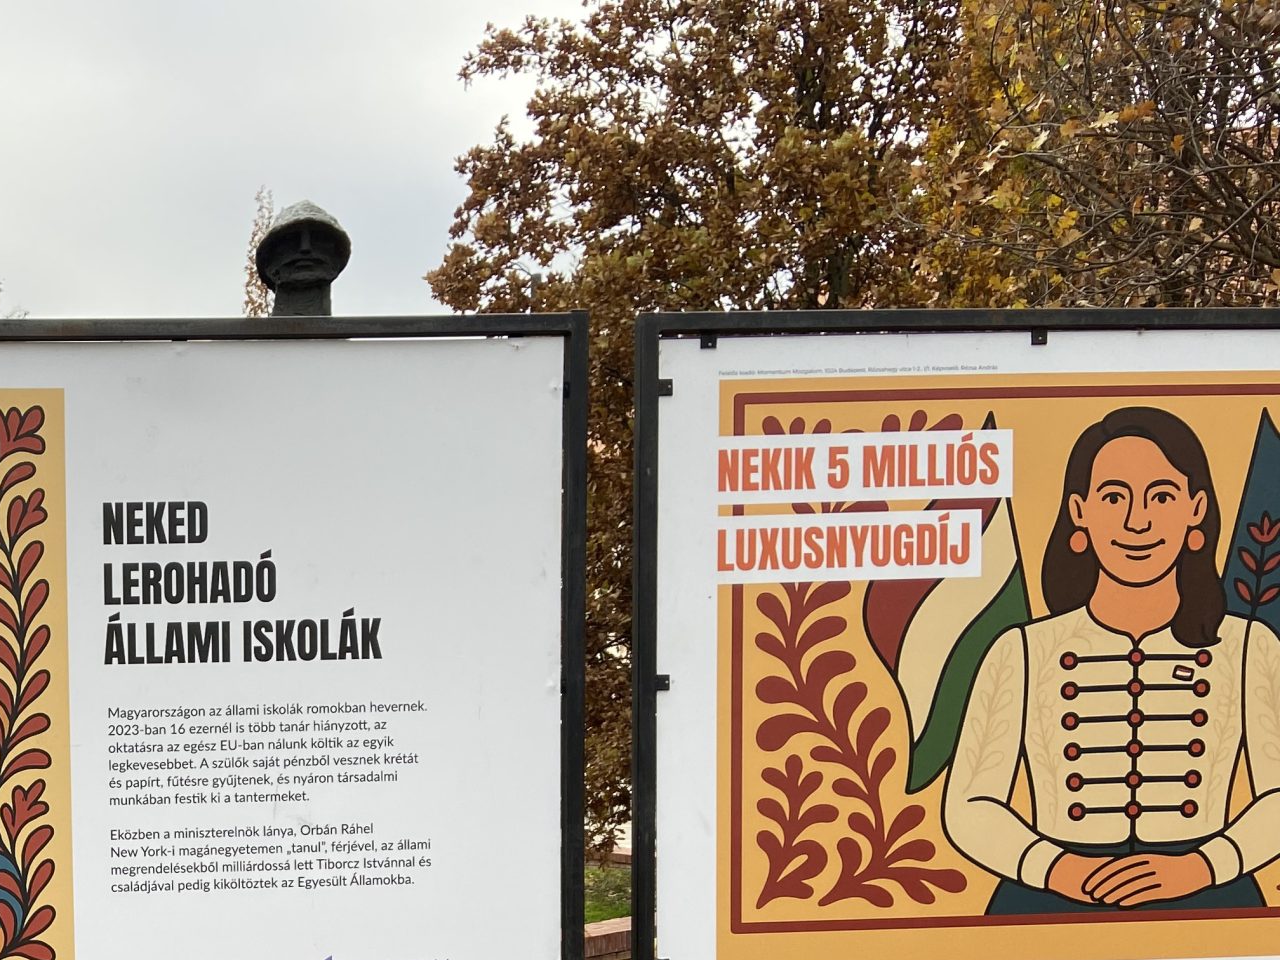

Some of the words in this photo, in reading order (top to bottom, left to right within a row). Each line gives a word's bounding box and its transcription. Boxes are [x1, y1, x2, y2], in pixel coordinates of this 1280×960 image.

[718, 446, 816, 492] NEKIK
[827, 445, 850, 490] 5
[862, 432, 1000, 488] MILLIÓS
[102, 501, 209, 545] NEKED
[717, 512, 971, 572] LUXUSNYUGDÍJ
[103, 549, 277, 606] LEROHADÓ
[104, 611, 231, 665] ÁLLAMI
[242, 606, 383, 663] ISKOLÁK
[107, 705, 205, 720] Magyarországon
[208, 708, 222, 716] az
[224, 703, 259, 716] állami
[262, 702, 303, 715] iskolák
[306, 701, 366, 714] romokban
[369, 699, 427, 712] hevernek.
[107, 723, 166, 736] 2023-ban
[170, 723, 185, 734] 16
[188, 721, 231, 734] ezernél
[235, 722, 244, 733] is
[247, 720, 276, 733] több
[278, 719, 310, 732] tanár
[312, 719, 370, 733] hiányzott,
[373, 722, 387, 730] az
[107, 740, 163, 753] oktatásra
[166, 744, 180, 752] az
[182, 739, 216, 754] egész
[219, 738, 264, 751] EU-ban
[267, 737, 307, 750] nálunk
[310, 736, 343, 748] költik
[346, 740, 359, 748] az
[362, 735, 394, 749] egyik
[108, 757, 197, 773] legkevesebbet.
[199, 758, 209, 769] A
[211, 756, 249, 768] szülők
[252, 755, 280, 770] saját
[283, 754, 329, 769] pénzből
[332, 752, 380, 765] vesznek
[383, 752, 419, 764] krétát
[108, 777, 122, 788] és
[125, 775, 163, 790] papírt,
[166, 775, 209, 787] fűtésre
[211, 773, 273, 788] gyűjtenek,
[276, 773, 290, 784] és
[293, 772, 333, 786] nyáron
[336, 769, 397, 783] társadalmi
[109, 793, 171, 806] munkában
[174, 792, 207, 804] festik
[210, 792, 220, 803] ki
[223, 795, 230, 803] a
[233, 789, 310, 803] tantermeket.
[110, 828, 160, 840] Eközben
[163, 831, 170, 839] a
[173, 825, 260, 839] miniszterelnök
[262, 824, 296, 838] lánya,
[299, 823, 337, 835] Orbán
[340, 822, 373, 835] Ráhel
[110, 846, 138, 857] New
[140, 844, 175, 857] York-i
[178, 843, 283, 858] magánegyetemen
[330, 839, 377, 854] férjével,
[380, 842, 394, 851] az
[396, 837, 430, 850] állami
[110, 860, 218, 877] megrendelésekből
[221, 859, 290, 872] milliárdossá
[293, 858, 313, 870] lett
[315, 857, 359, 870] Tiborcz
[363, 855, 415, 868] Istvánnal
[418, 856, 431, 867] és
[110, 879, 174, 894] családjával
[177, 878, 210, 893] pedig
[213, 876, 278, 889] kiköltöztek
[297, 874, 347, 889] Egyesült
[349, 872, 414, 886] Államokba.
